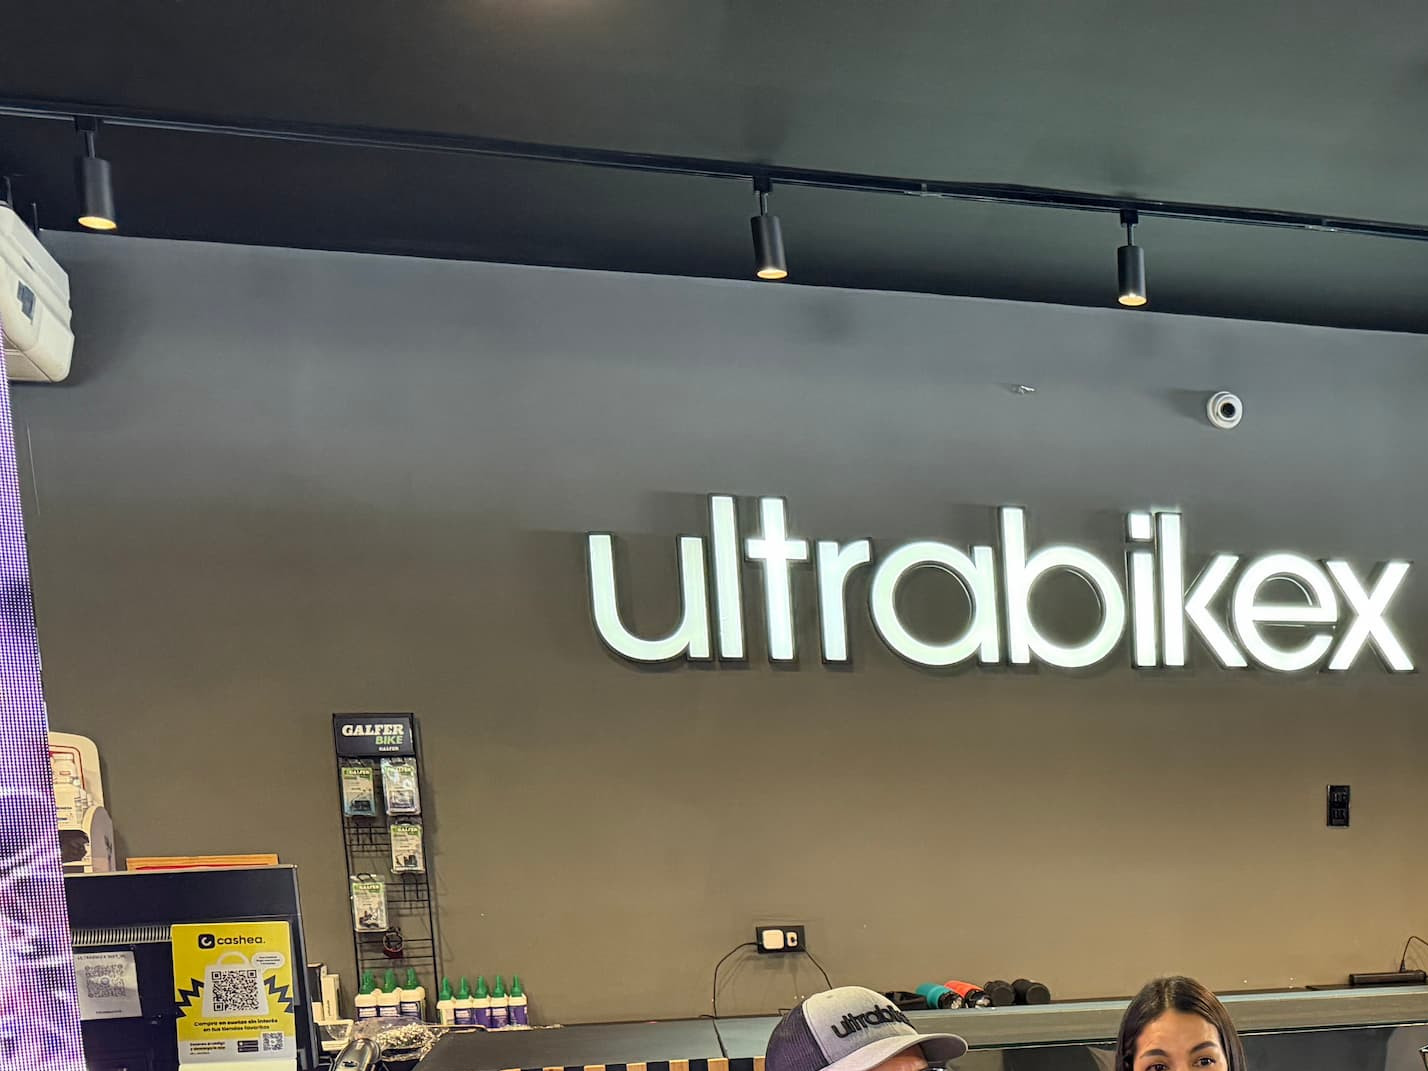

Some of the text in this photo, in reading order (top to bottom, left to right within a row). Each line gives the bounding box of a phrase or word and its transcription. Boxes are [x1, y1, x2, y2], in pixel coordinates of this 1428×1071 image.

[587, 494, 1416, 674] ultrabikex
[342, 724, 404, 736] GALFER
[375, 735, 403, 744] BIKE
